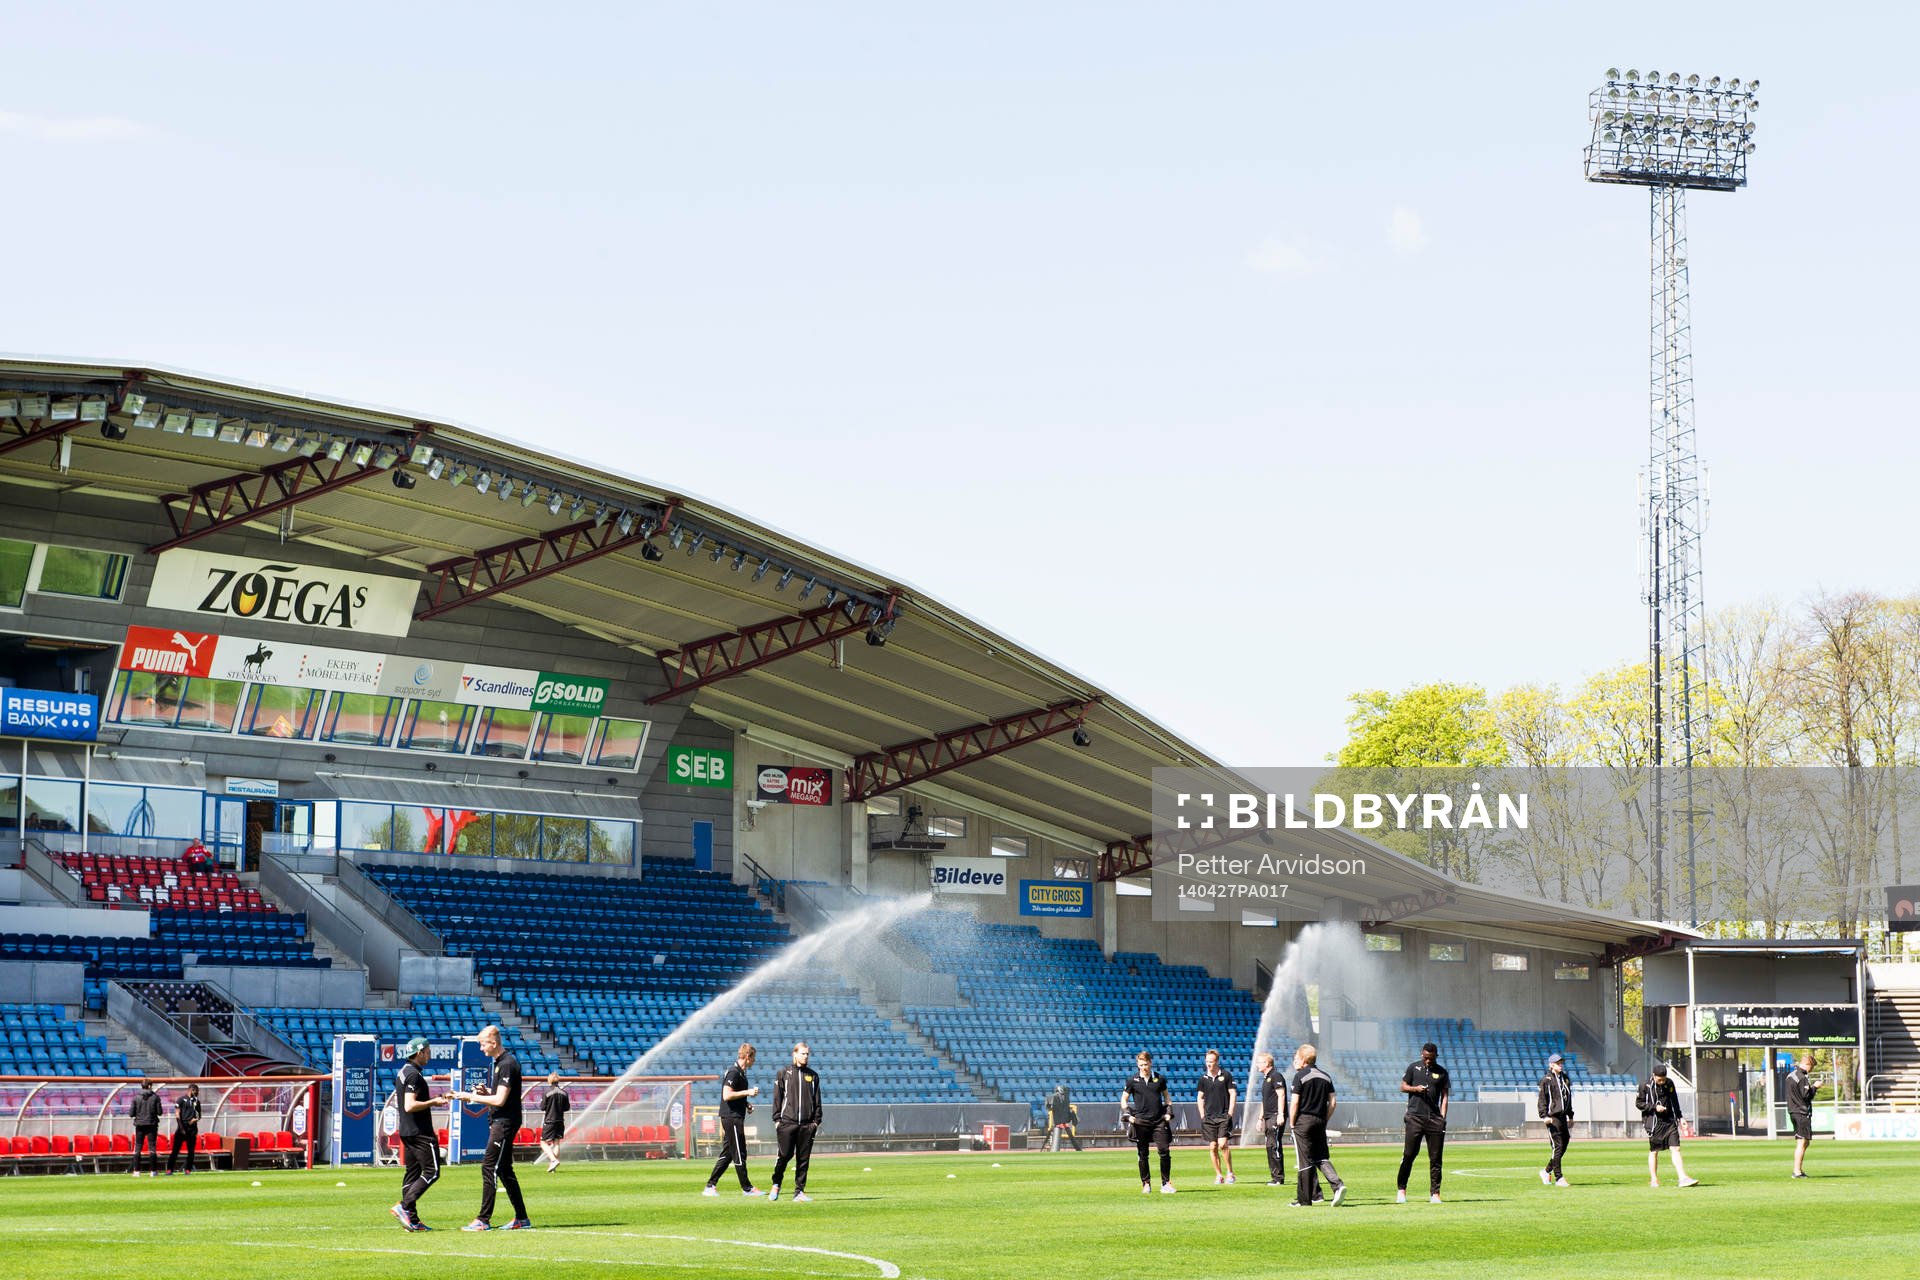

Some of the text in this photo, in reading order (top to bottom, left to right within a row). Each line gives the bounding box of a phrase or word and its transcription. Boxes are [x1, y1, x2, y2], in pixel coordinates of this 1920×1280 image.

[131, 647, 188, 674] PUMA
[326, 659, 360, 670] EKEBY
[305, 668, 372, 684] MÖBELAFFÄR
[394, 686, 442, 697] support syd
[474, 679, 535, 697] Scandlines
[552, 682, 604, 703] SOLID
[8, 697, 91, 716] RESURS
[8, 712, 58, 728] BANK
[676, 753, 725, 781] SEB
[228, 786, 277, 795] RESTAURANG
[791, 777, 824, 796] mix
[791, 792, 822, 804] MEGAPOL
[934, 867, 1004, 885] Bildeve
[1031, 888, 1081, 902] CITY GROSS
[1723, 1014, 1799, 1028] Fönsterputs
